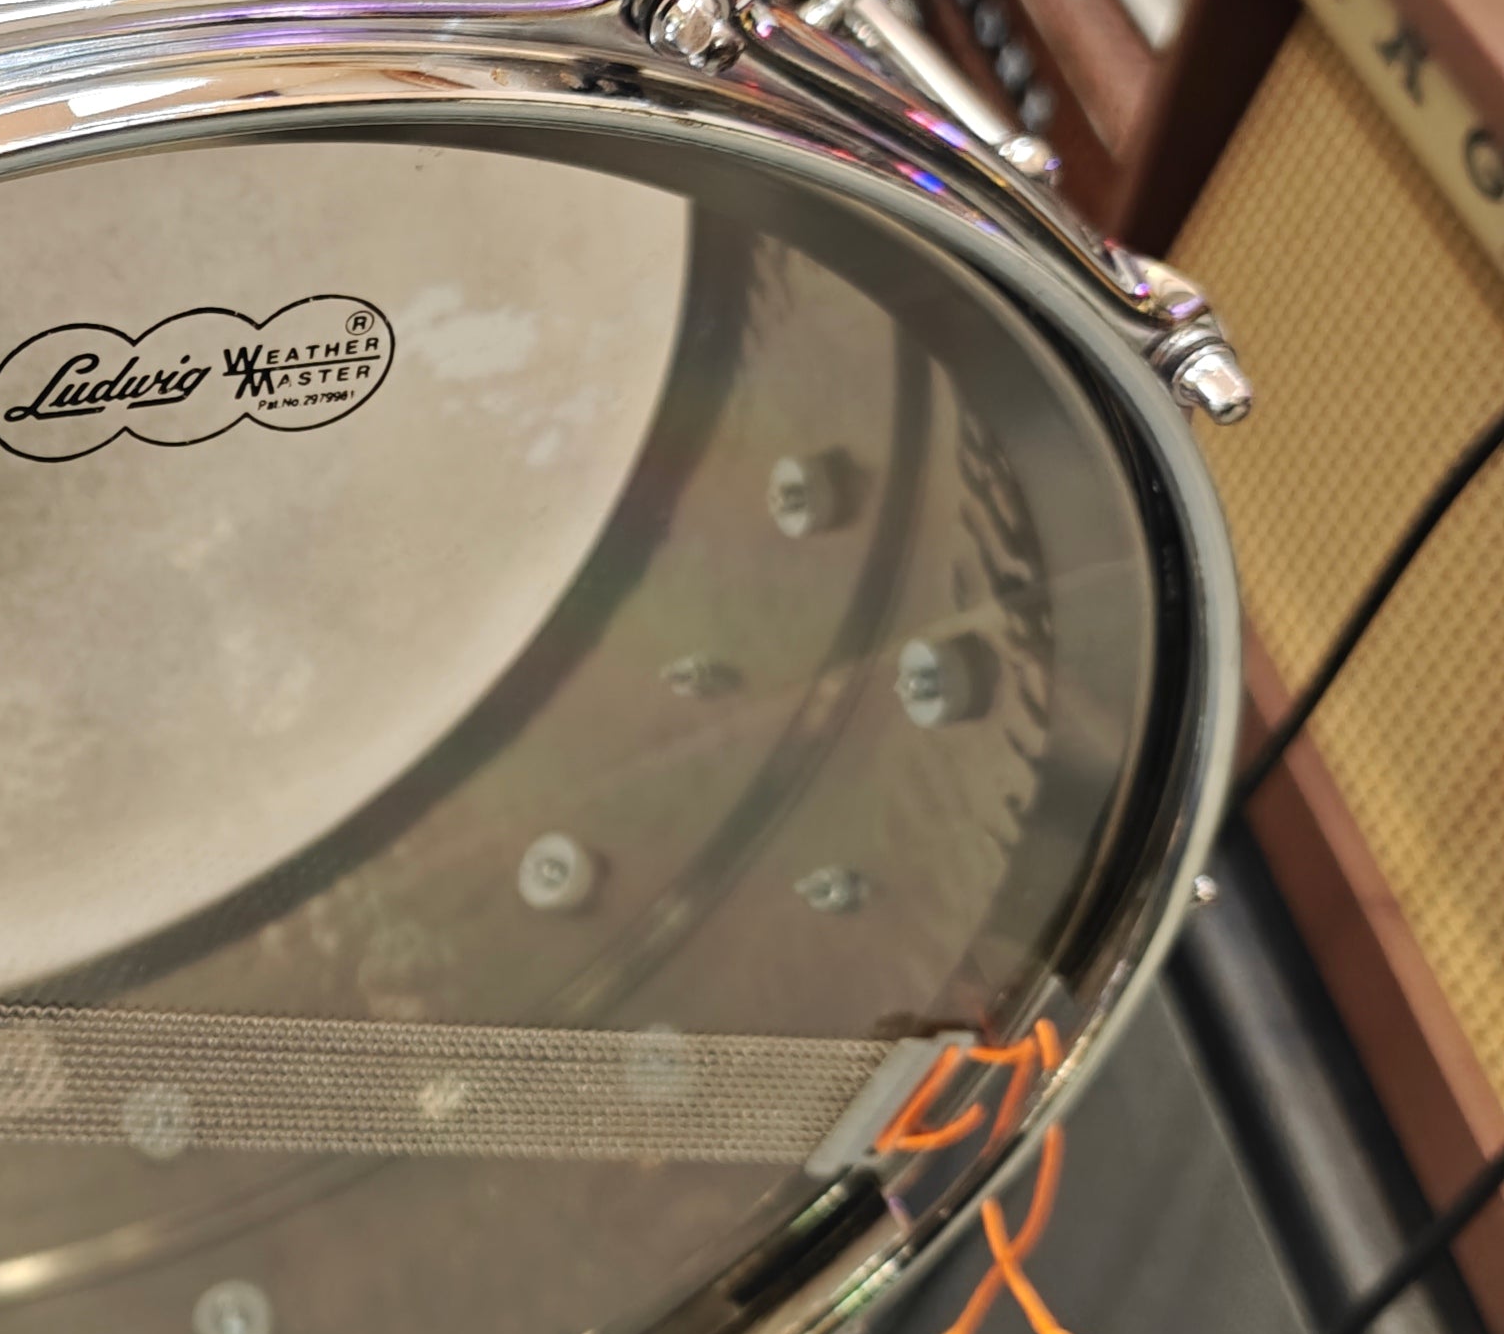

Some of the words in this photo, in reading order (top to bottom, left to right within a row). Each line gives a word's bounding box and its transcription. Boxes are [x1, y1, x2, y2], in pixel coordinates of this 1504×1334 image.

[223, 337, 380, 375] WEATHER
[3, 353, 213, 422] Ludwig
[234, 364, 371, 400] MASTER
